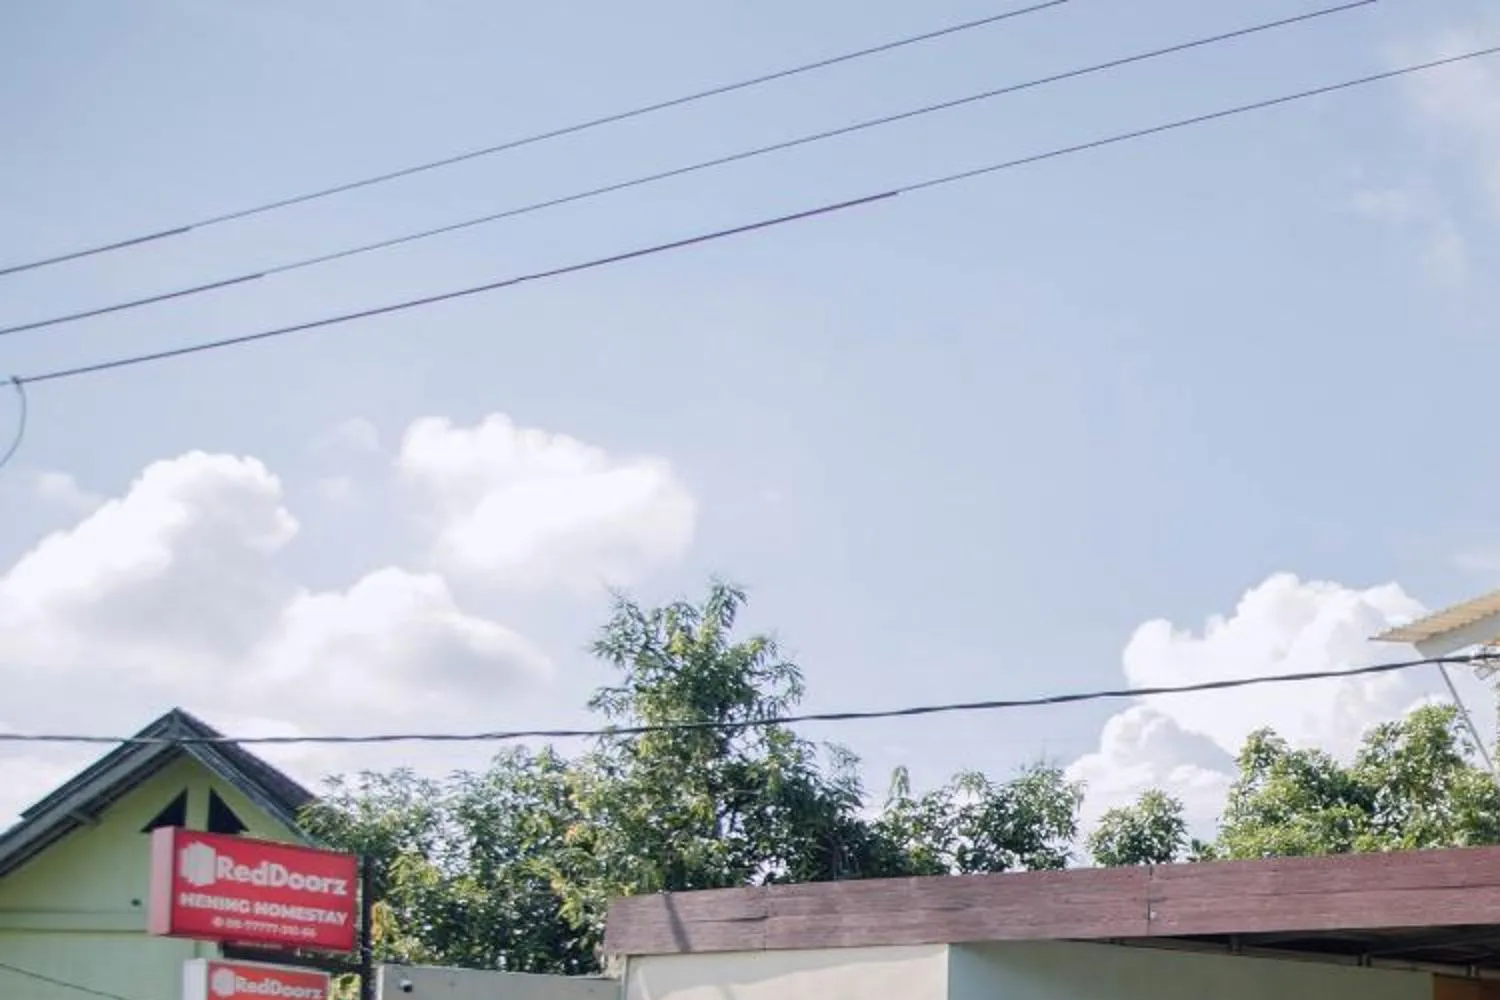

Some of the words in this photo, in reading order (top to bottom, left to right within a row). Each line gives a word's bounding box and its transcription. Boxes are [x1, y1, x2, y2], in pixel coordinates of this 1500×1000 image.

[216, 854, 348, 896] RedDoorz
[254, 900, 348, 926] HOMESTAY
[235, 974, 323, 1000] RedDoorz
